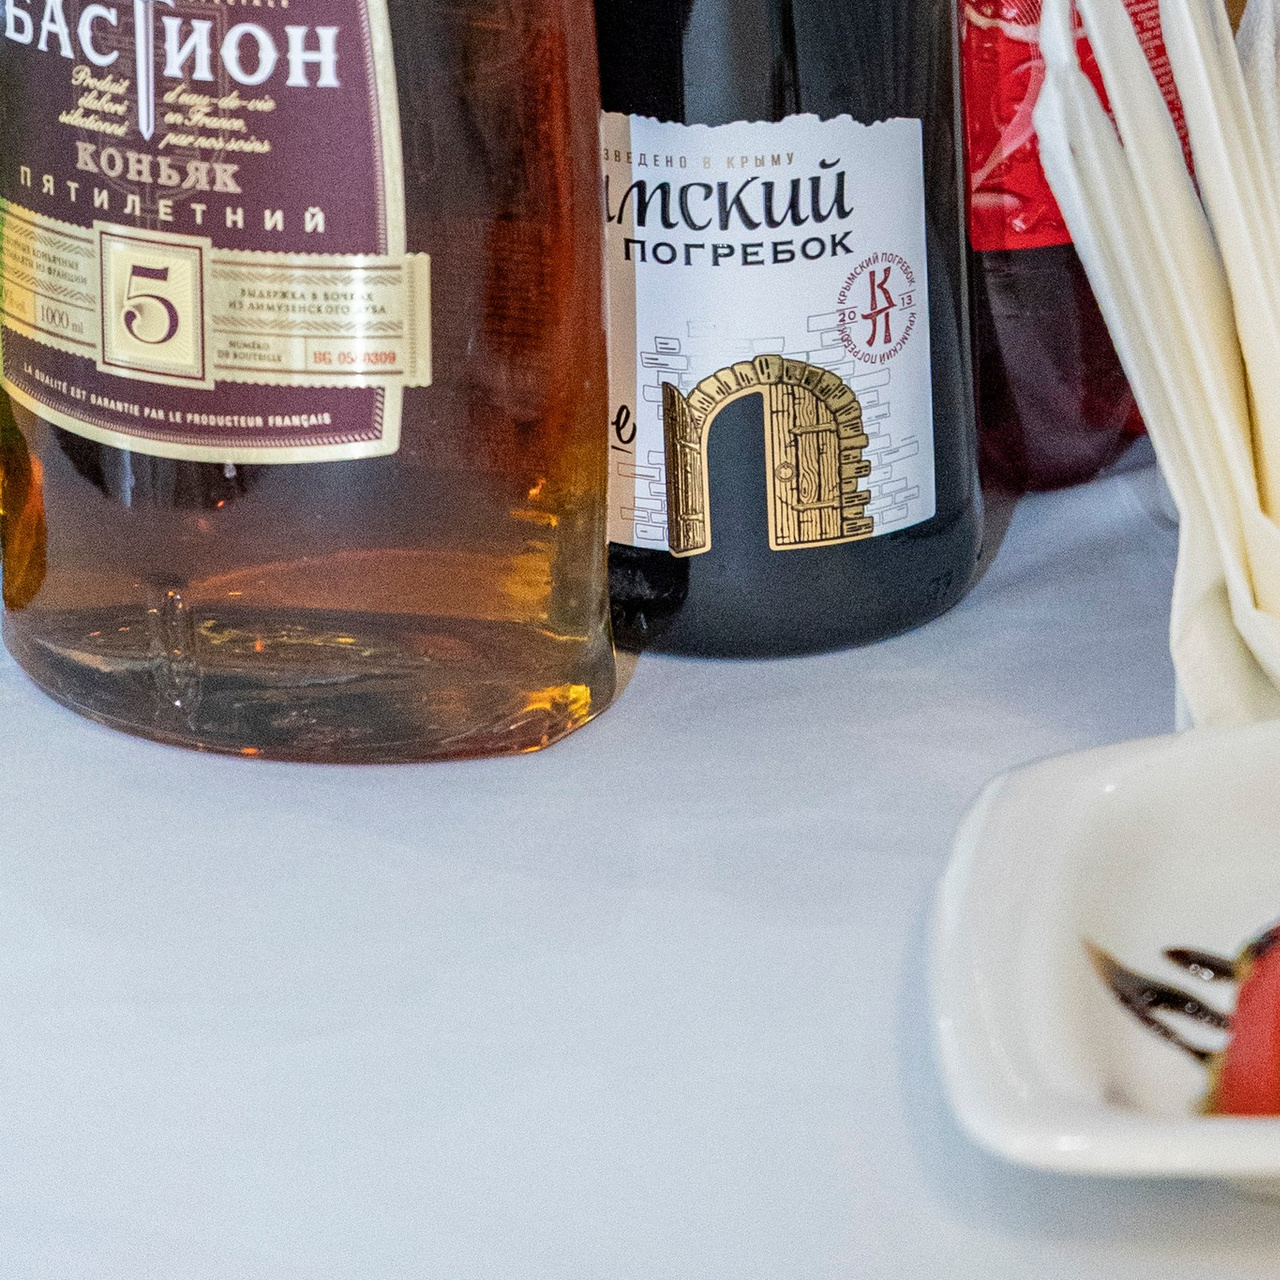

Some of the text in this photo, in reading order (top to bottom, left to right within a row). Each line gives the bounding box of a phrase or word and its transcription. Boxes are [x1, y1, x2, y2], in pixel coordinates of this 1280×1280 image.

[76, 141, 242, 194] КОНЬЯК
[603, 148, 795, 169] ЗВЕДЕНО В КРЫМУ
[20, 166, 325, 233] ПЯТИЛЕТНИЙ
[624, 230, 854, 266] ПОГРЕБОК
[323, 291, 374, 302] БОЧХ
[837, 252, 917, 305] КРЫМСКИЙ ПОГРЕБОК
[41, 305, 69, 329] 1000
[124, 265, 180, 344] 5
[880, 312, 917, 365] КРЫМСКИЙ
[71, 384, 87, 400] EST
[144, 406, 164, 420] PAR
[169, 411, 183, 423] LE
[186, 412, 264, 428] PRODUCTEUR
